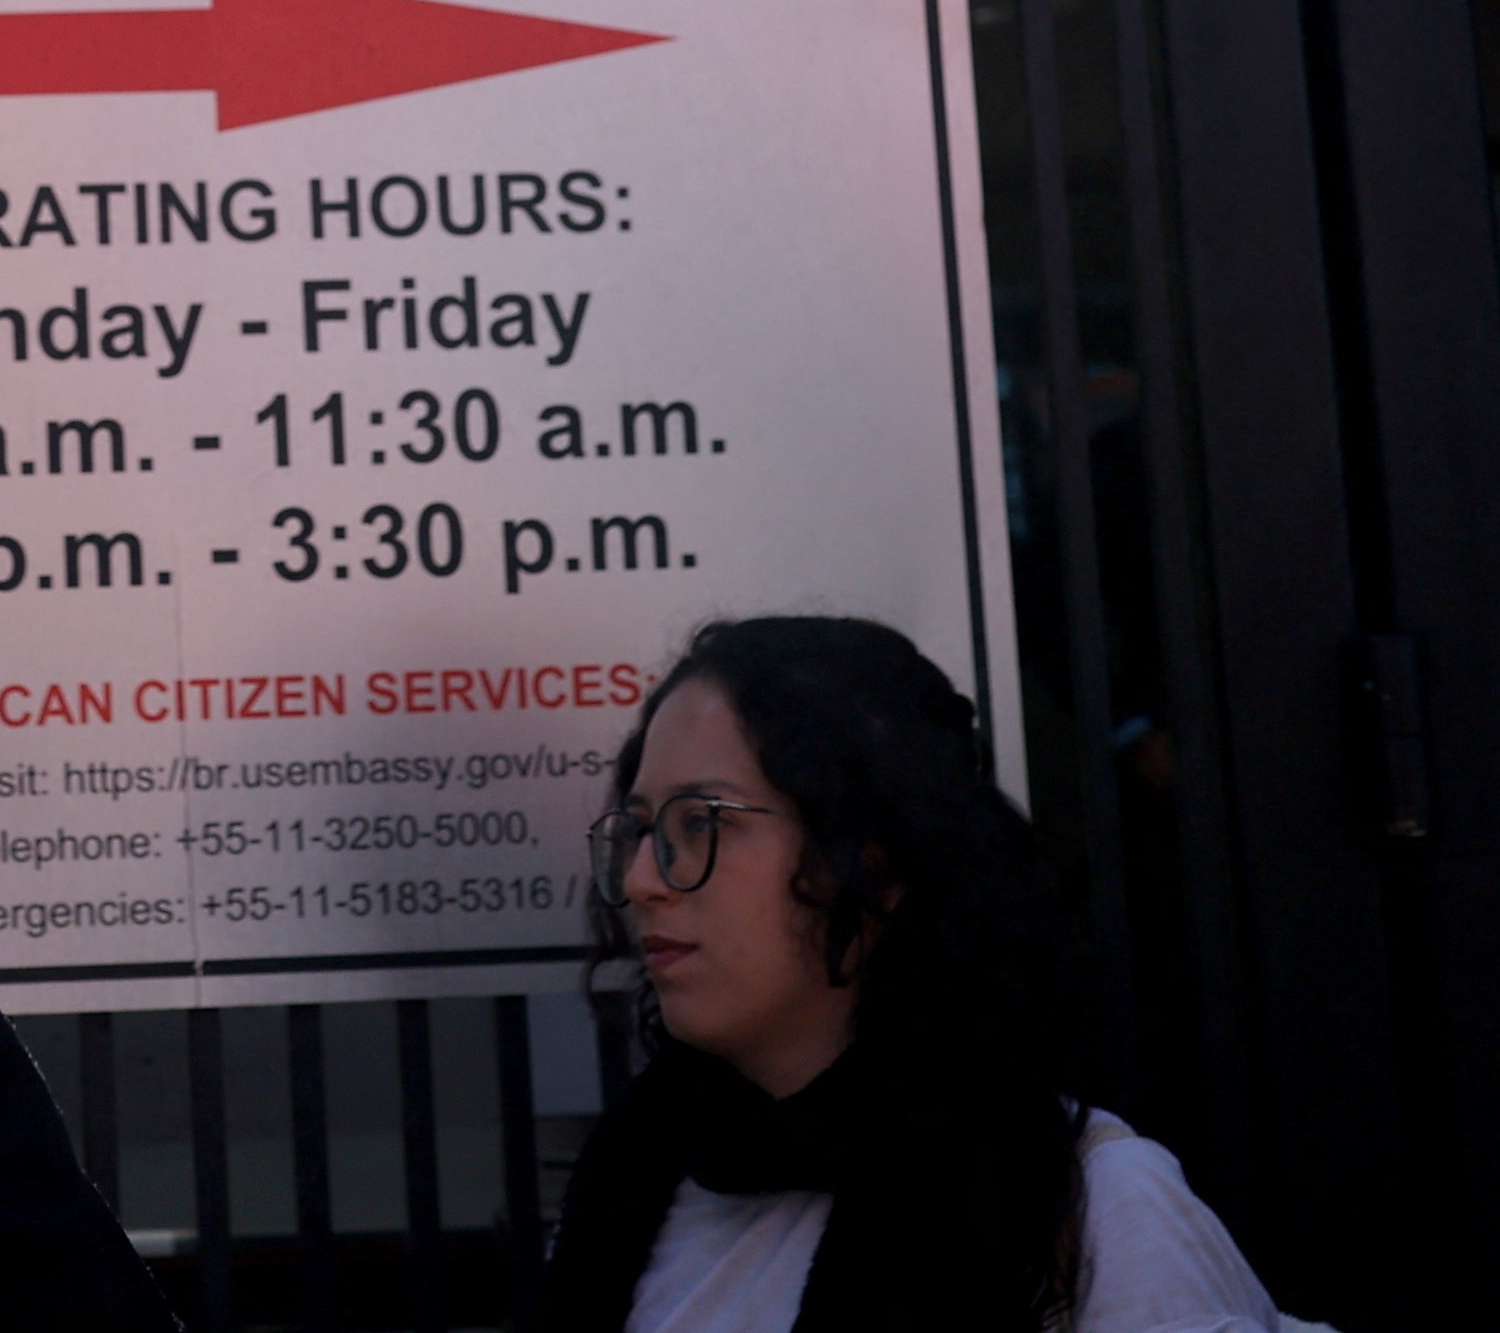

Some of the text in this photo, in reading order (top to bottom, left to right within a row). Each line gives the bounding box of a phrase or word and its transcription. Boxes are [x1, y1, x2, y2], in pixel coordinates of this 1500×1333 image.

[309, 171, 635, 240] HOURS:
[302, 277, 591, 366] Friday
[255, 389, 500, 468] 11:30
[537, 396, 728, 459] a.m.
[272, 502, 465, 583] 3:30
[502, 511, 699, 593] p.m.
[134, 675, 346, 725] CITIZEN
[177, 810, 540, 857] +55-11-3250-5000,
[203, 876, 553, 923] +55-11-5183-5316
